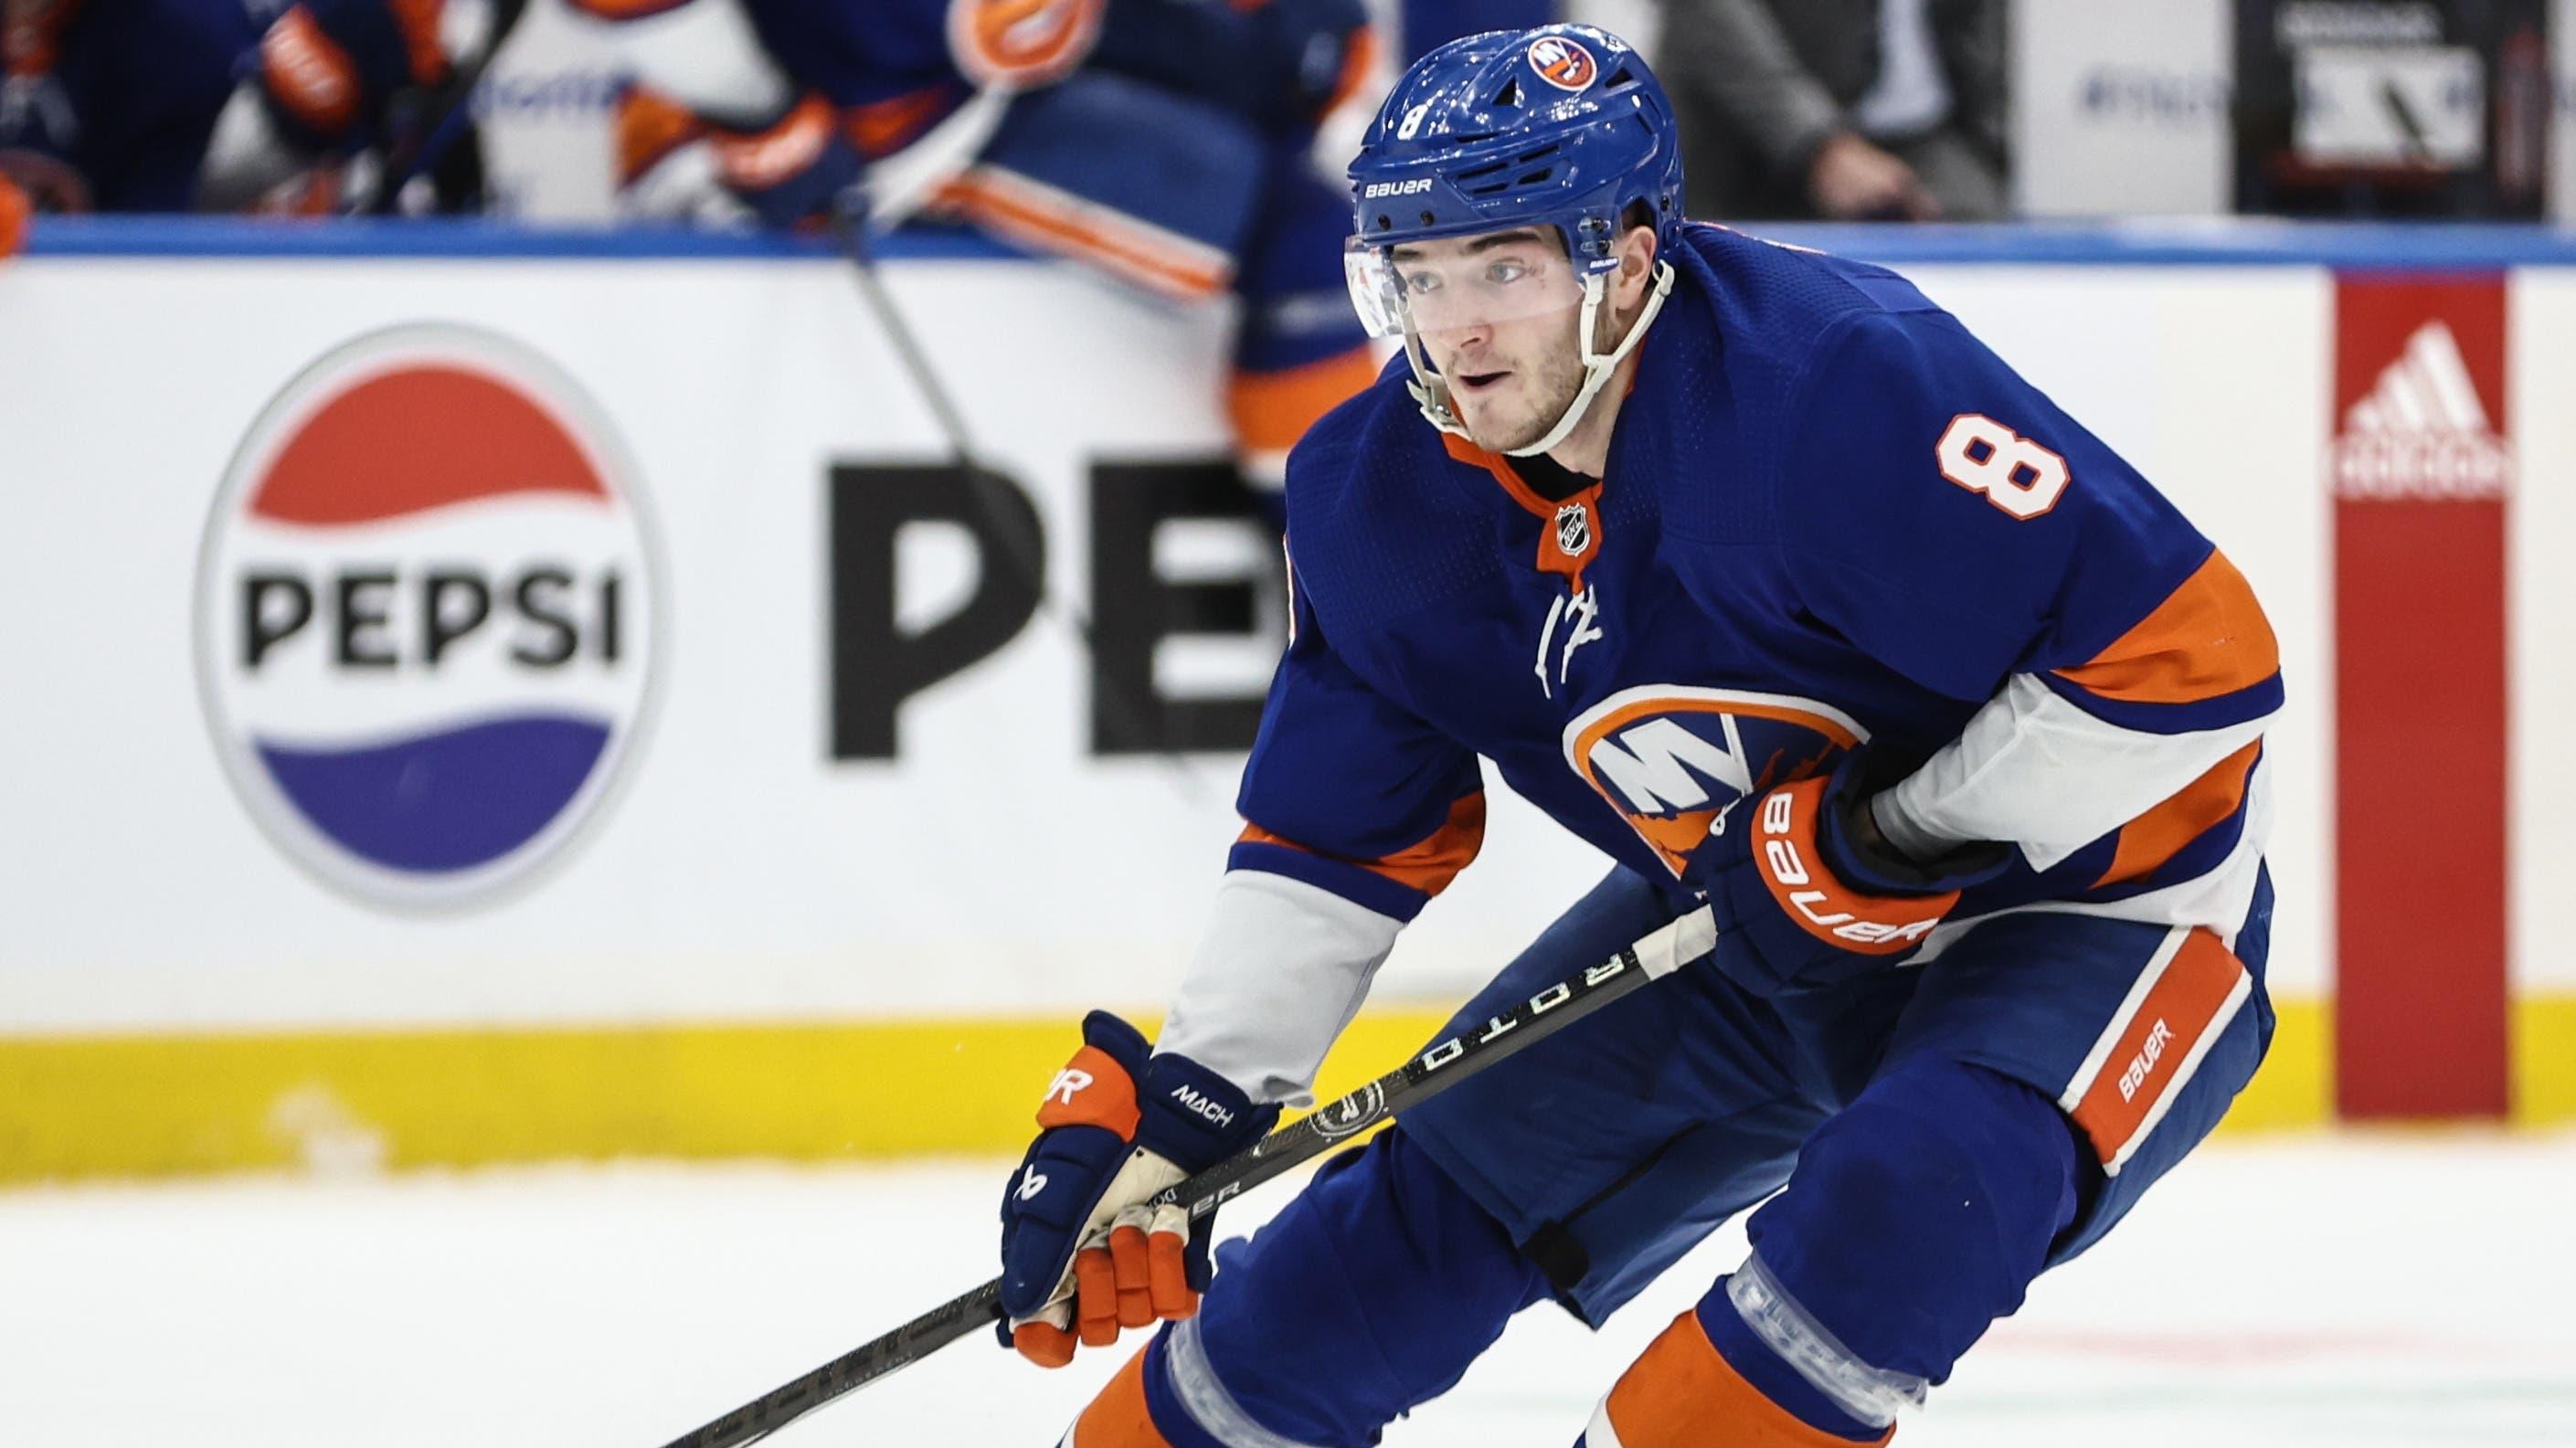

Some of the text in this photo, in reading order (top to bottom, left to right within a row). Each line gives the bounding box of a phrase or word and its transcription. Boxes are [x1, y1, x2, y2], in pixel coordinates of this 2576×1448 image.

[1397, 103, 1428, 141] 8
[1364, 178, 1432, 198] BAUER
[1935, 413, 2071, 521] 8
[239, 568, 622, 671] PEPSI
[1763, 791, 1940, 944] BAUER
[2118, 1017, 2176, 1104] BAUER
[1171, 1083, 1235, 1128] MACH
